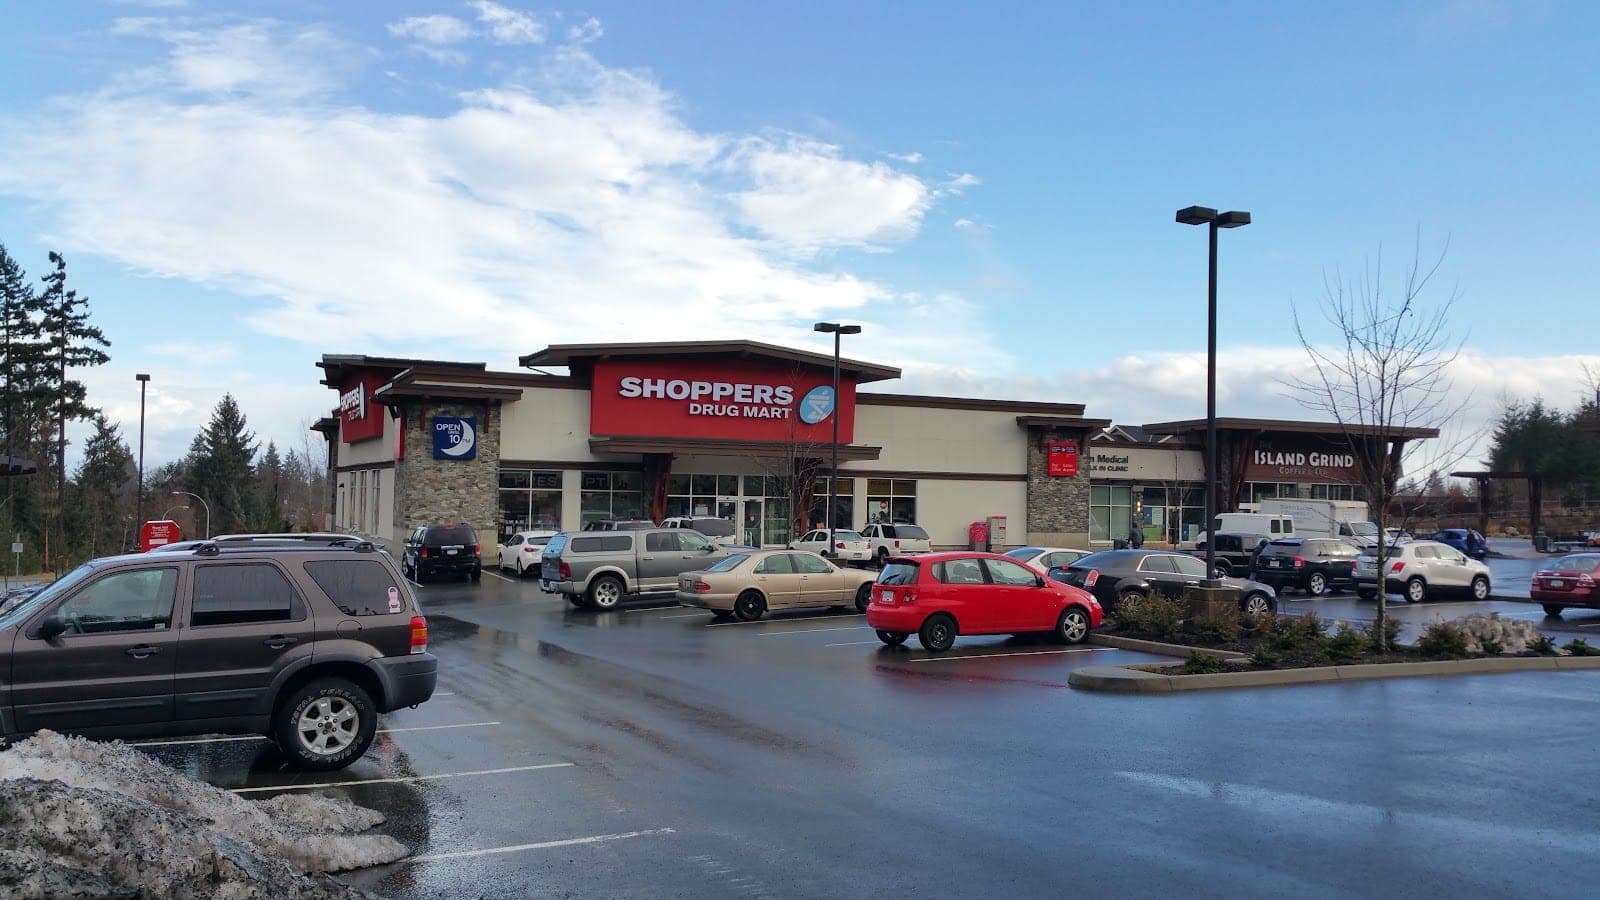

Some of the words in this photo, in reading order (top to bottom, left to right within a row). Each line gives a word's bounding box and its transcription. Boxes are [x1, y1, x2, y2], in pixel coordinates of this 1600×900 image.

[618, 376, 794, 406] SHOPPERS
[689, 403, 740, 417] DRUG
[743, 405, 792, 419] MART
[436, 423, 461, 431] OPEN
[449, 434, 461, 444] 10
[1097, 454, 1129, 464] Medical
[1254, 449, 1306, 466] ISLAND
[1309, 451, 1354, 468] GRIND
